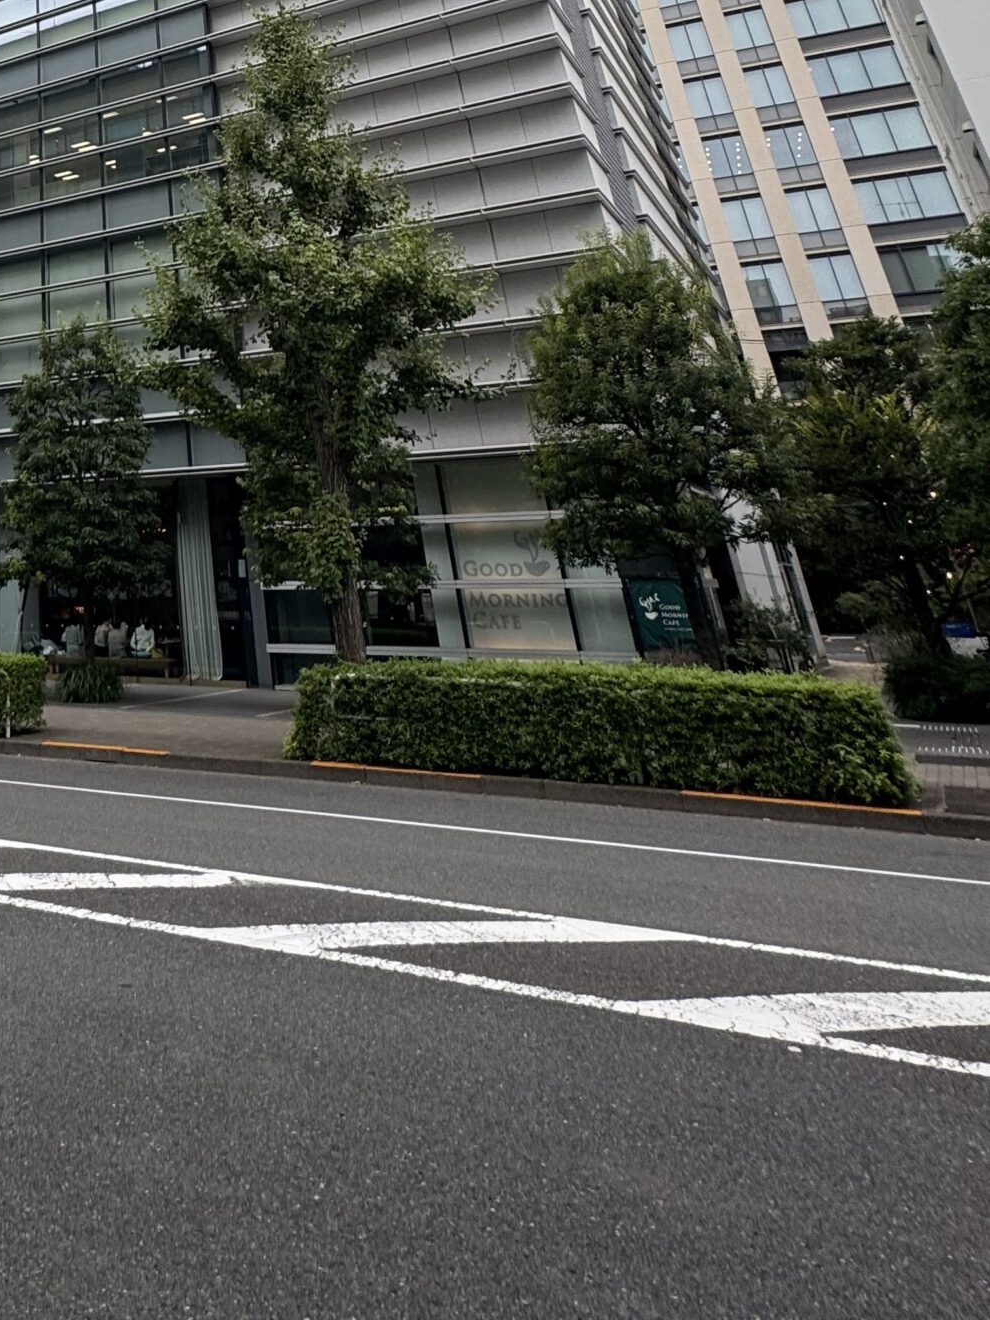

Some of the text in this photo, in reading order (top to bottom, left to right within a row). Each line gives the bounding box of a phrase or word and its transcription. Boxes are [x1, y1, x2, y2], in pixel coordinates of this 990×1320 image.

[463, 560, 524, 577] GOOD
[470, 591, 566, 608] MORNING
[473, 611, 523, 630] CAFE
